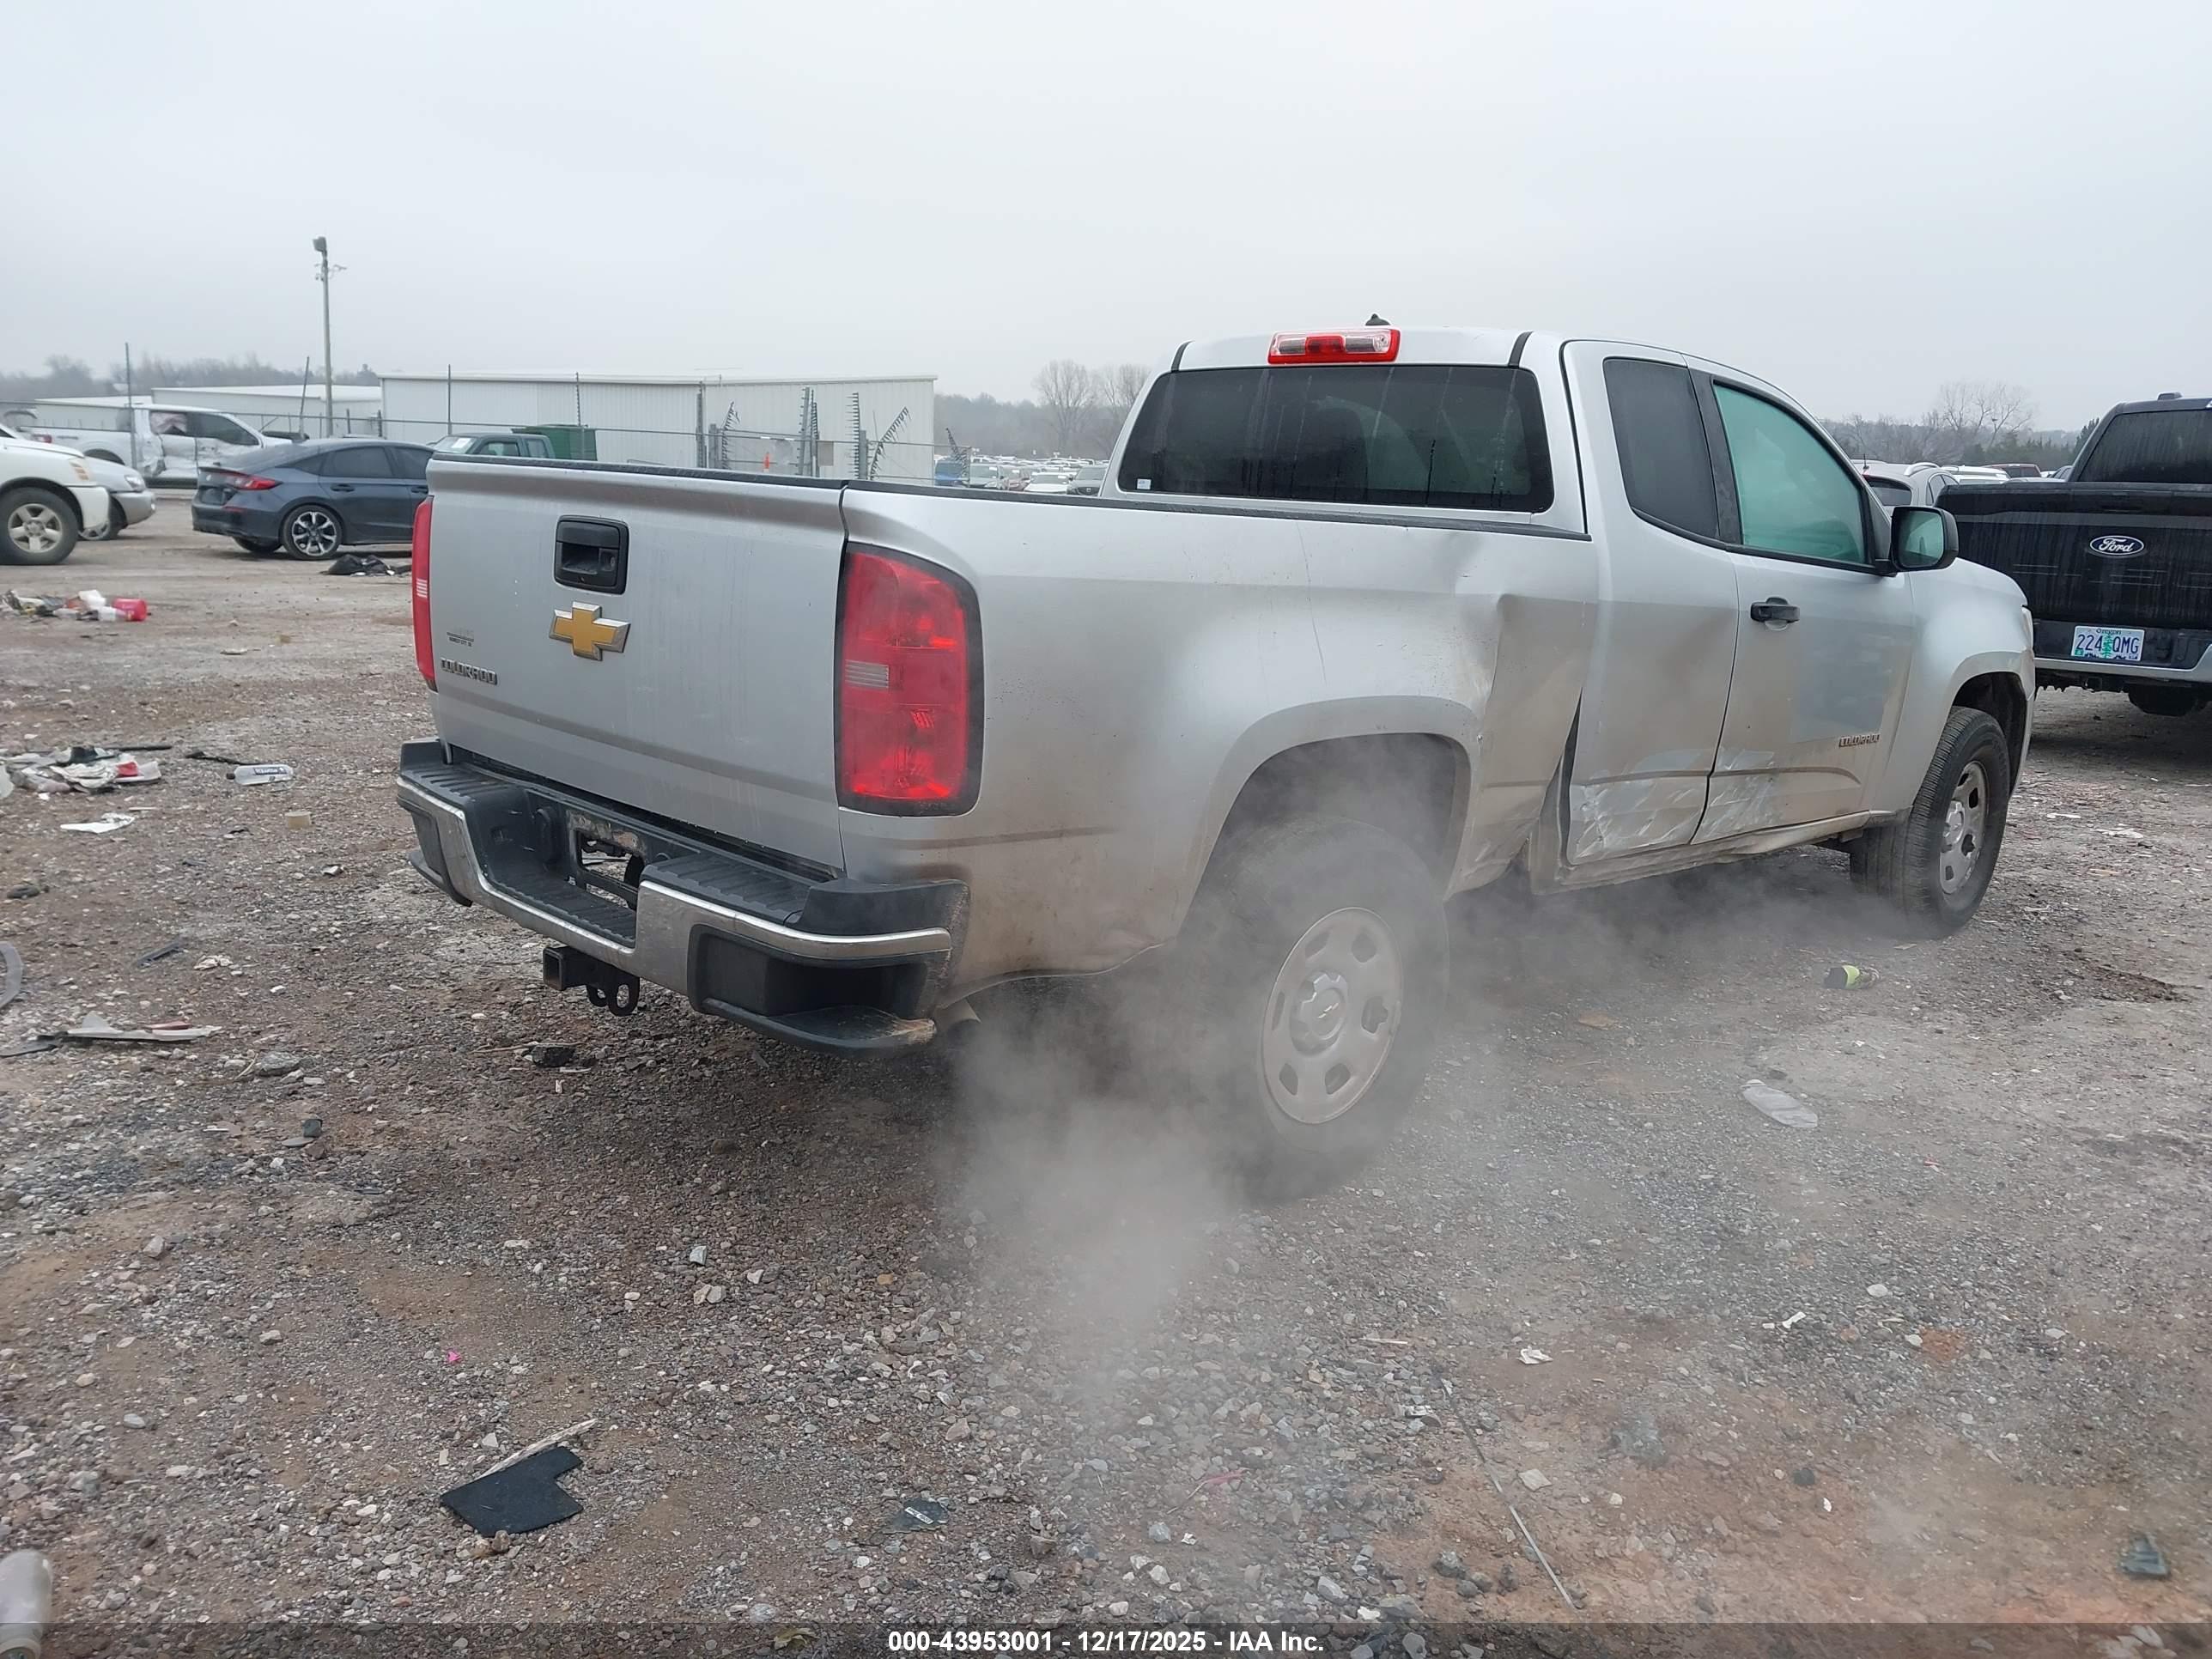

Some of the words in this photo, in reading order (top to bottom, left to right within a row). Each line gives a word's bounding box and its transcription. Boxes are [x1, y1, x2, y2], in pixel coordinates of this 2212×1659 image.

[2099, 538, 2136, 552] Ford
[2076, 634, 2103, 651] 224
[2112, 635, 2140, 653] QMG
[440, 657, 498, 686] COLORADO
